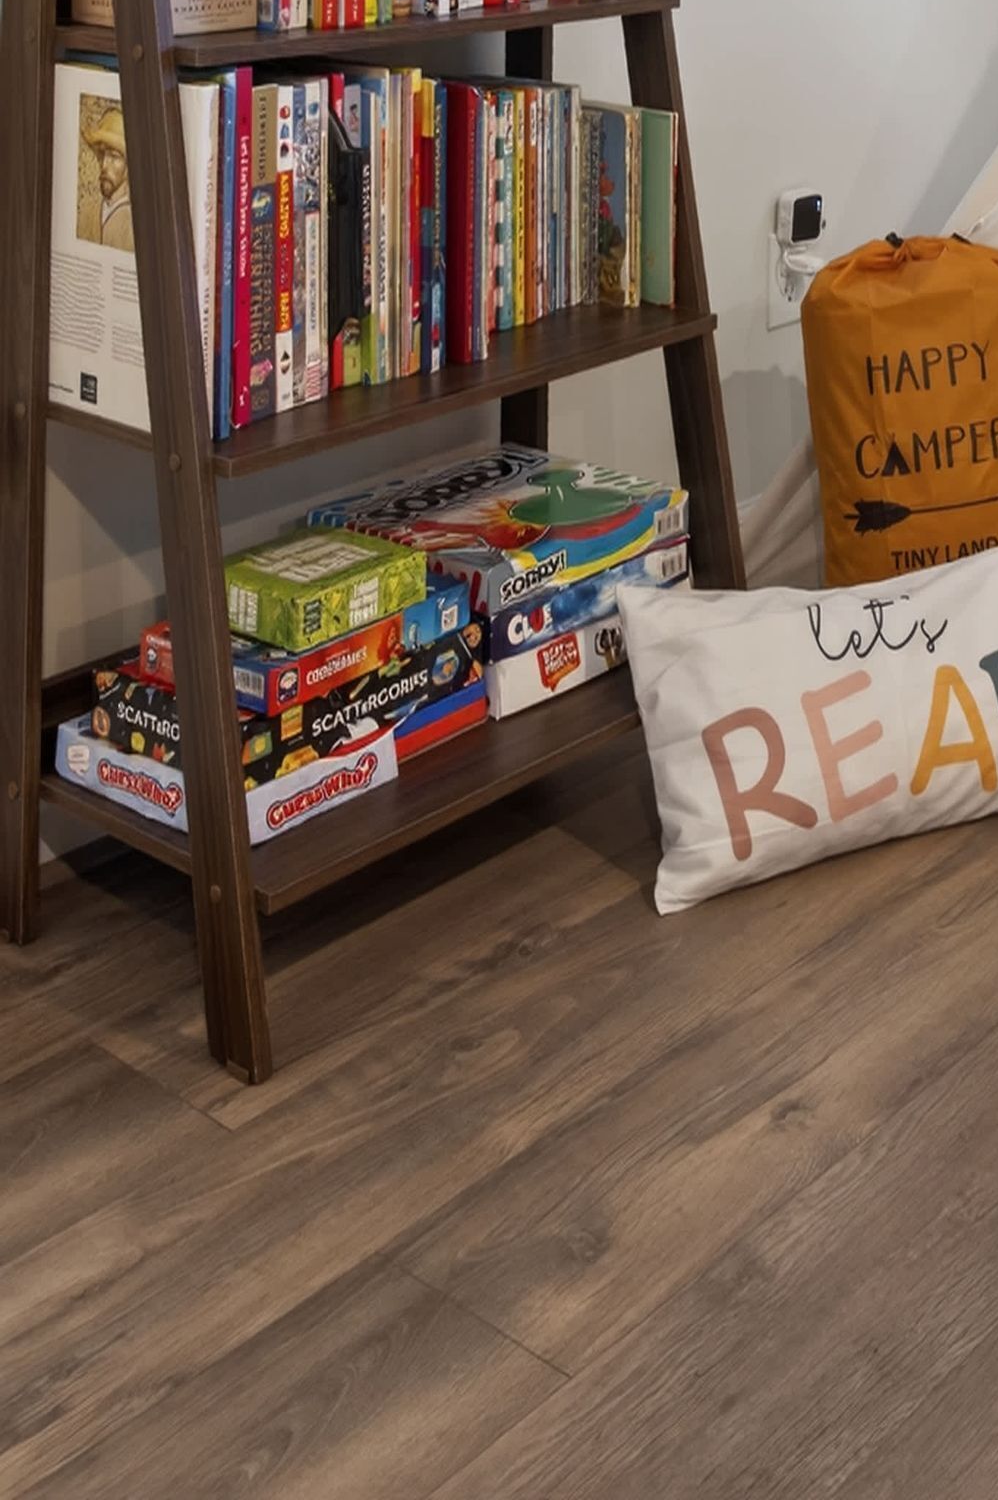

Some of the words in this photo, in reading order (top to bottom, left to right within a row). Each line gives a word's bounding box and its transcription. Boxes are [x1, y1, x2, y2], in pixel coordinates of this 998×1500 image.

[866, 339, 990, 396] HAPPY
[502, 551, 567, 603] SORRY!
[890, 545, 940, 571] TINY
[507, 603, 554, 646] CLUE
[311, 668, 429, 738] SCATTERGORIES
